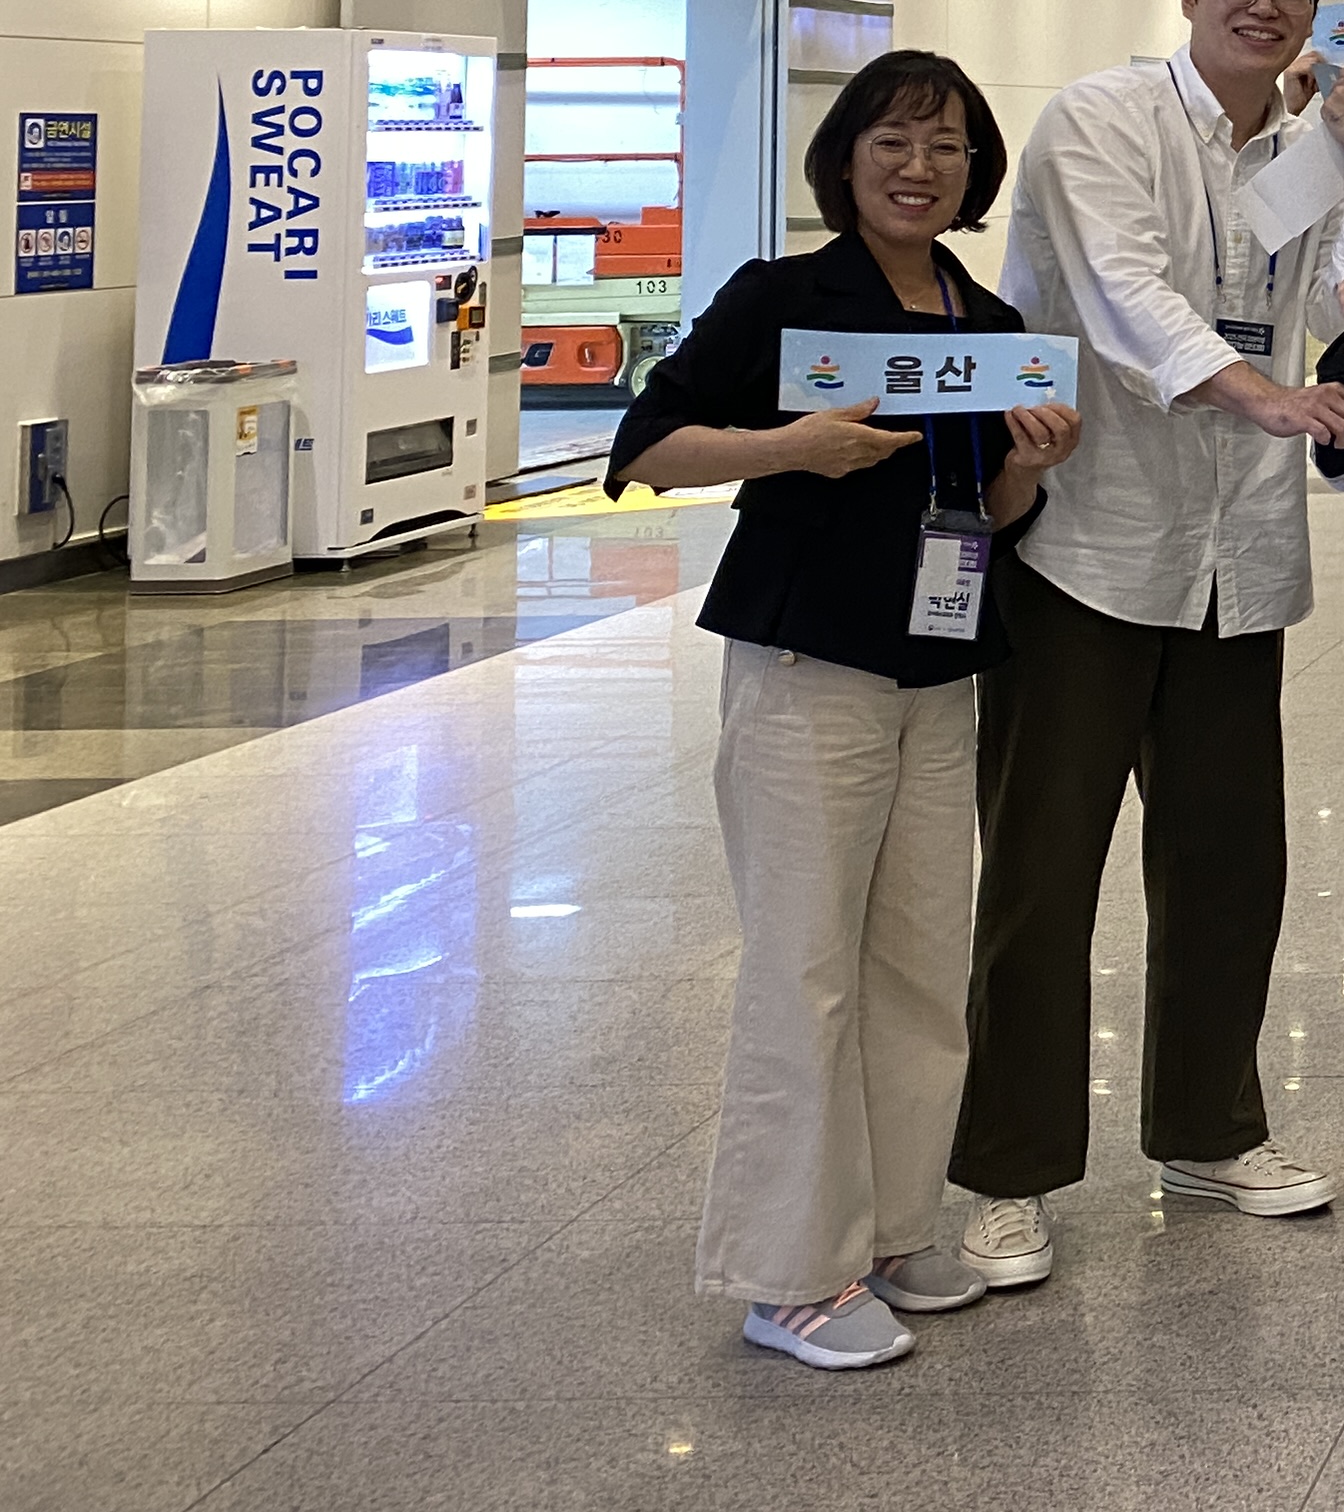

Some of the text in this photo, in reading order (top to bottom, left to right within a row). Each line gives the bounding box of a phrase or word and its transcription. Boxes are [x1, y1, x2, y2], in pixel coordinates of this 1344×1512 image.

[247, 69, 287, 262] SWEAT
[284, 70, 323, 279] POCARI
[595, 230, 623, 244] 30
[636, 279, 667, 294] 103
[883, 354, 977, 395] 울산
